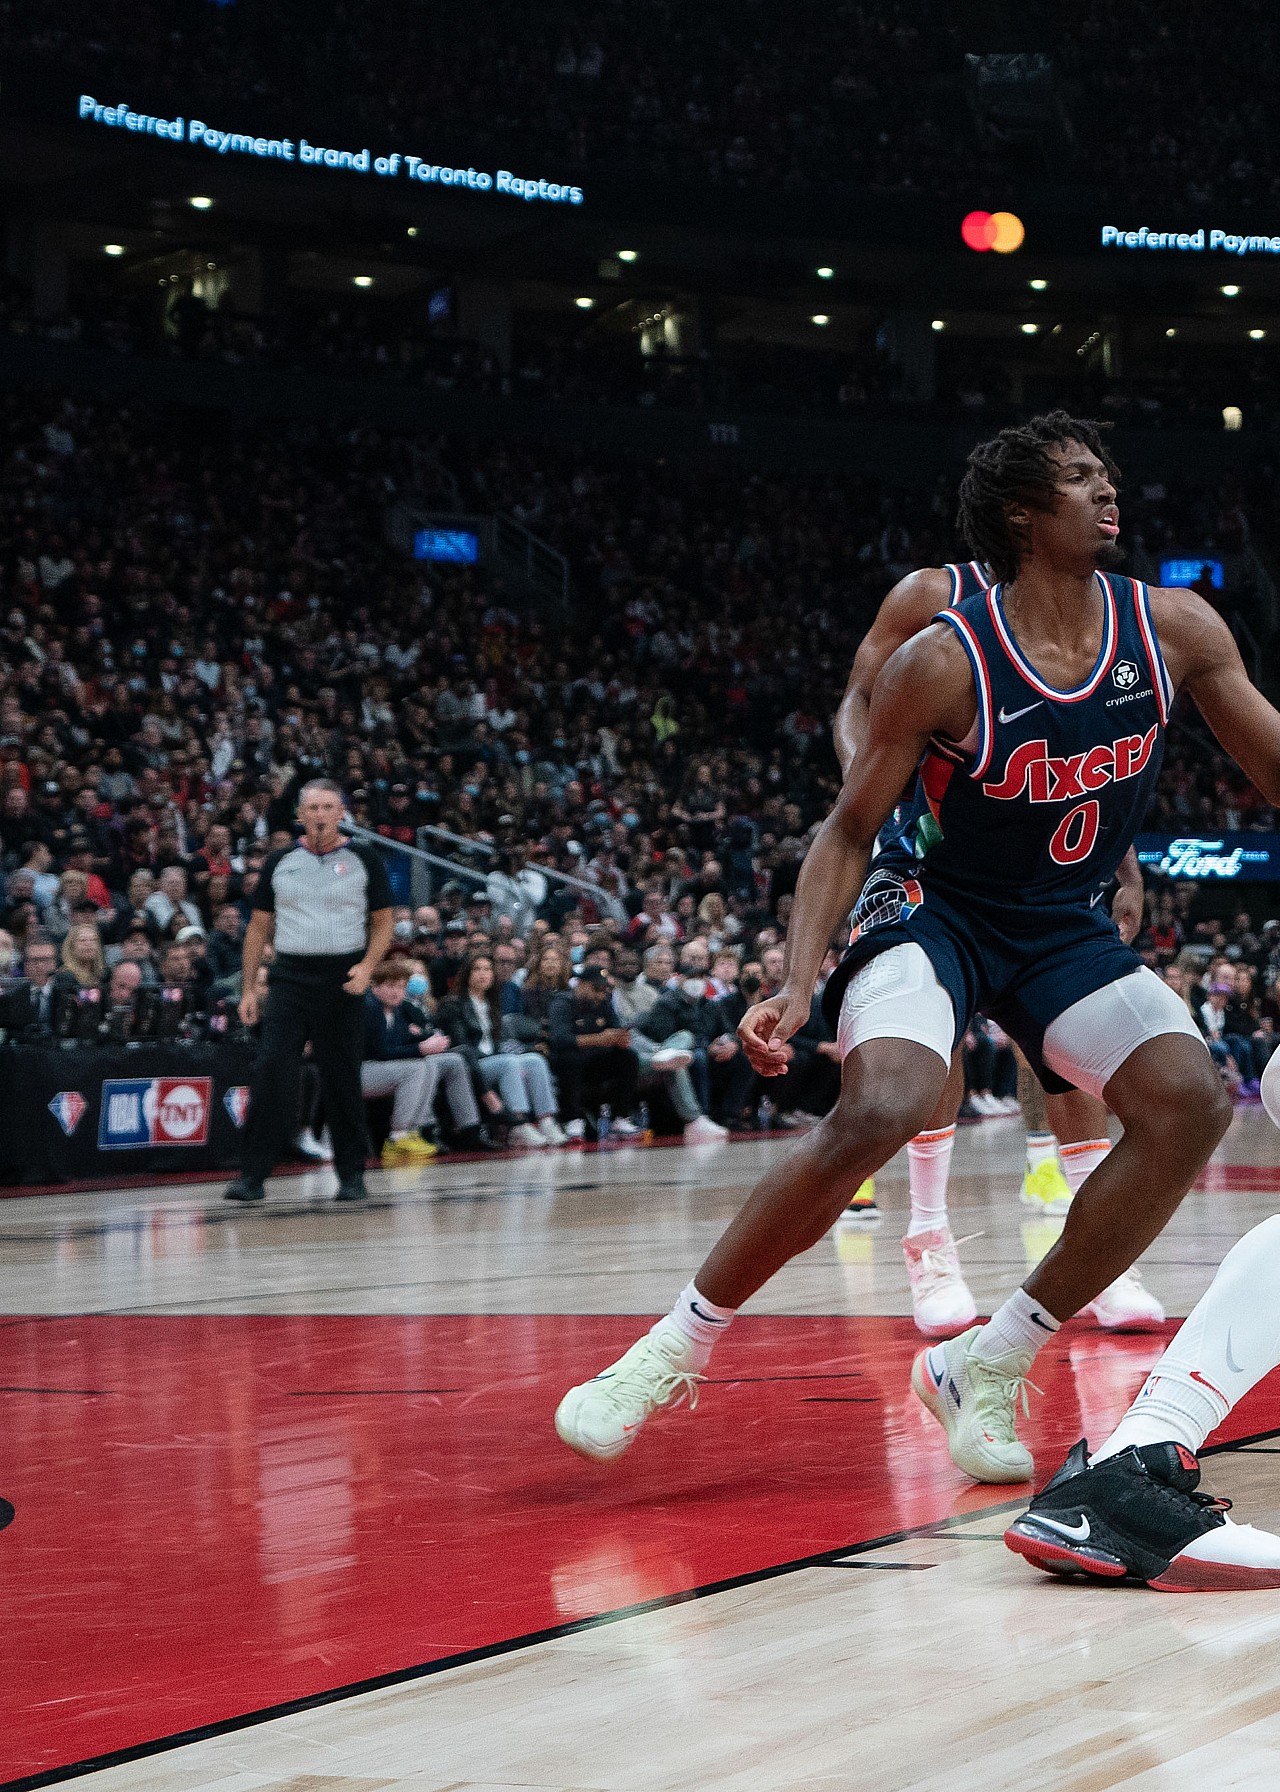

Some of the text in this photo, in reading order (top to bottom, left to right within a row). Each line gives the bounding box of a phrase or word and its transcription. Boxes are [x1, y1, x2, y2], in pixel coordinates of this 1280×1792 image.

[79, 94, 584, 204] Preferred Payment brand of Toronto Raptors
[1101, 225, 1205, 250] Preferred
[1105, 687, 1154, 708] crypto.com
[982, 722, 1159, 804] Sixers
[1049, 799, 1100, 865] 0
[1160, 838, 1245, 876] Ford
